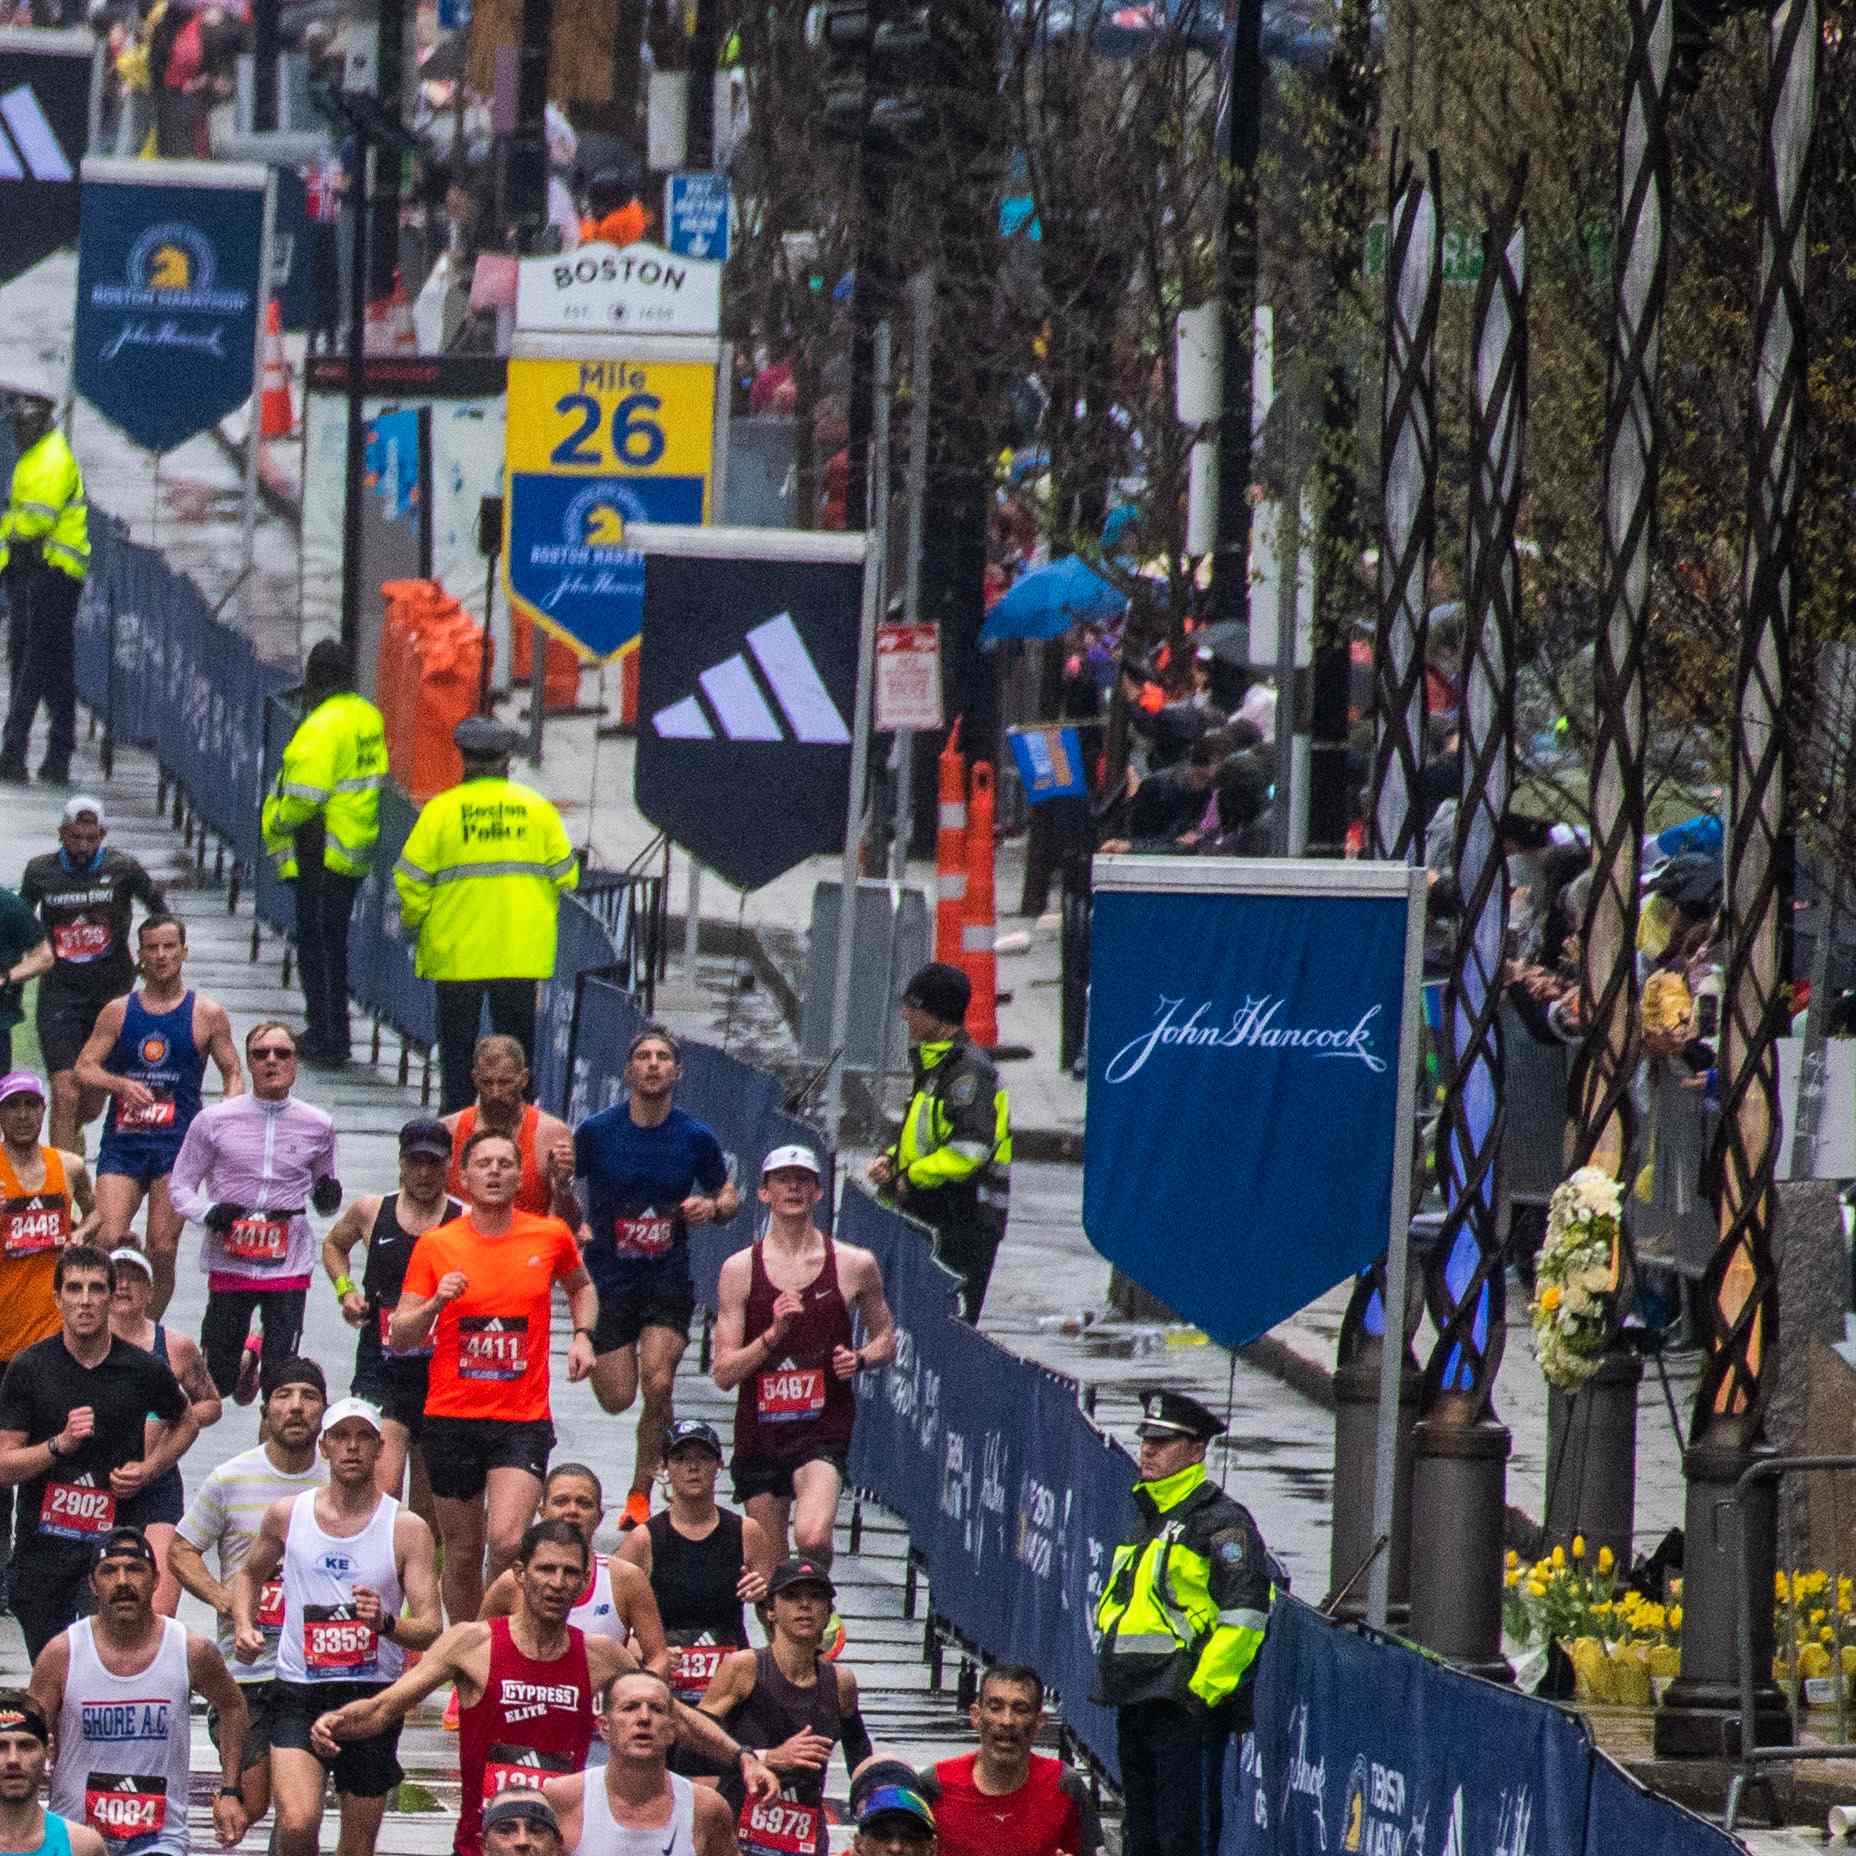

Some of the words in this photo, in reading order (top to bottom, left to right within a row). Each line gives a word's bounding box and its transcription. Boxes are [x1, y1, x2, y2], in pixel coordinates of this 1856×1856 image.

[554, 254, 686, 292] BOSTON
[579, 363, 646, 393] Mile
[550, 395, 665, 467] 26
[462, 802, 528, 820] Boston
[462, 820, 528, 845] Police
[1104, 994, 1238, 1085] John
[1230, 994, 1388, 1074] Hancock
[468, 1337, 519, 1359] 4411
[53, 1492, 109, 1519] 2902
[325, 1557, 350, 1570] KE
[504, 1682, 575, 1705] CYPRESS
[82, 1710, 134, 1739] SHORE
[504, 1704, 547, 1724] ELITE
[495, 1770, 549, 1794] 121
[94, 1797, 156, 1823] 4084
[751, 1807, 810, 1836] 6978
